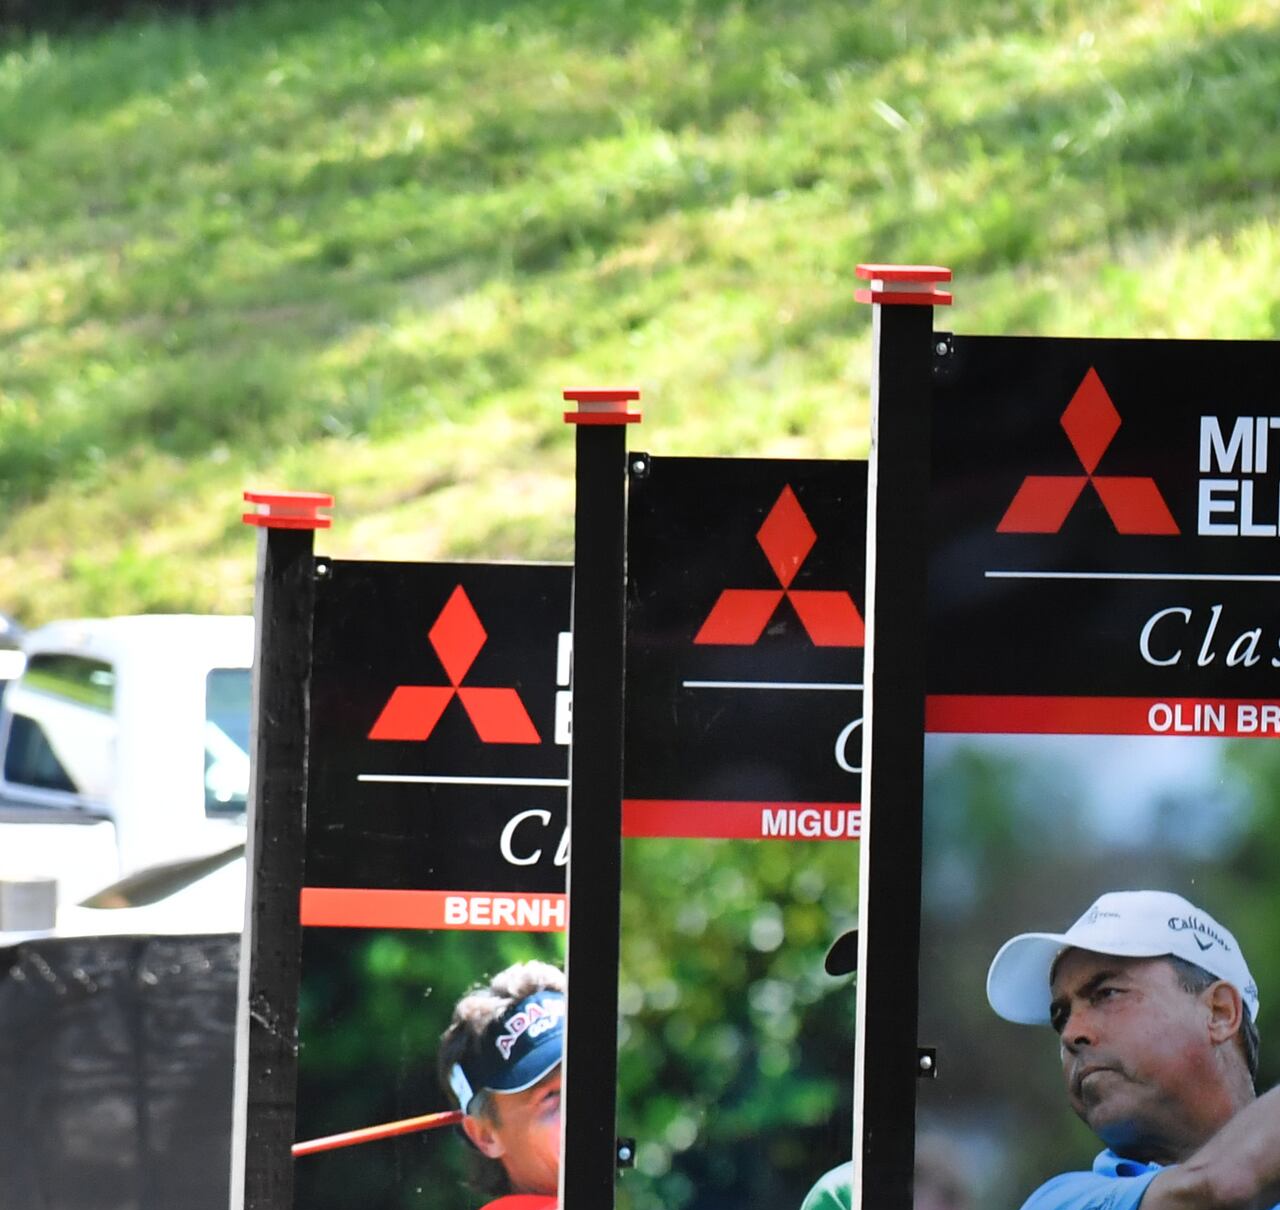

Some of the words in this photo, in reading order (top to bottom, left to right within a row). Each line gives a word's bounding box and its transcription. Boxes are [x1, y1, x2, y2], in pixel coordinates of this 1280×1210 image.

[1148, 703, 1225, 732] OLIN
[761, 808, 861, 837] MIGUE
[443, 896, 566, 927] BERNH
